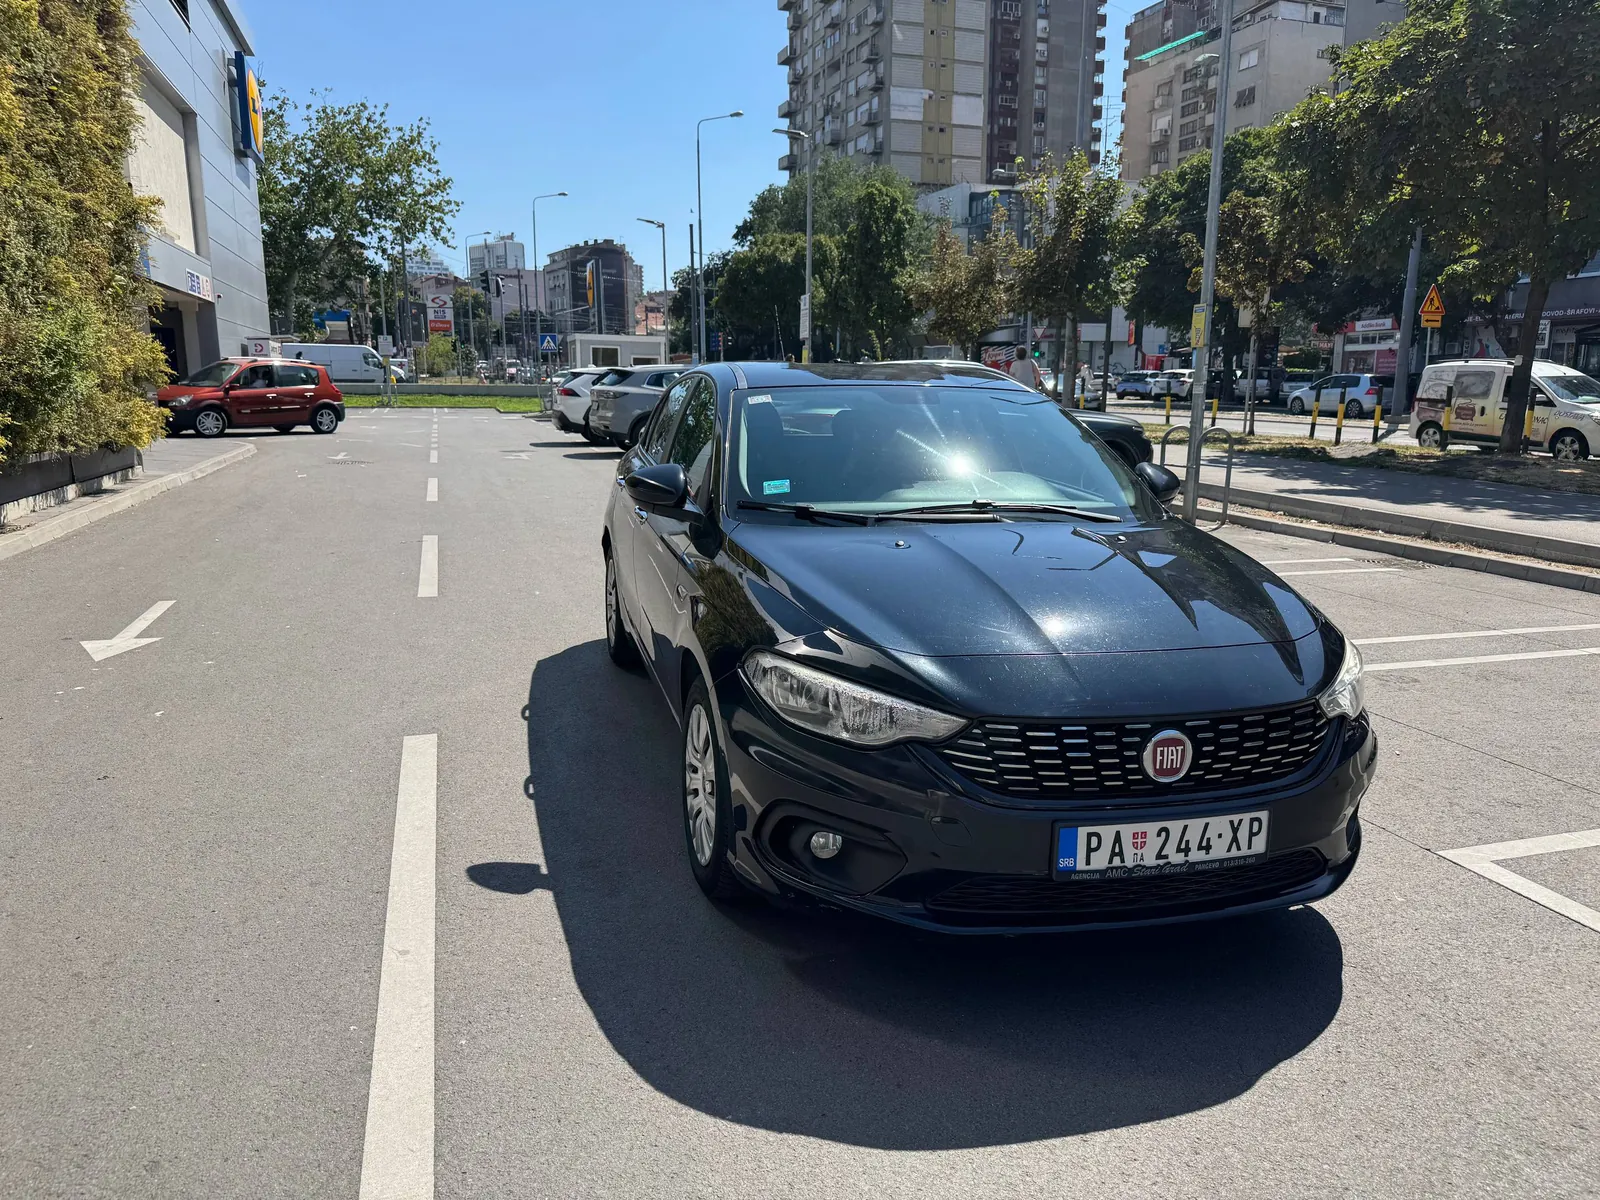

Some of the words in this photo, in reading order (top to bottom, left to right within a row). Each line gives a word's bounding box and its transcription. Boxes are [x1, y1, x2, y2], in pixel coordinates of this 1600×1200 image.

[1156, 746, 1184, 769] FIAT
[1085, 830, 1126, 866] PA
[1058, 858, 1075, 868] SRB
[1070, 872, 1100, 880] AGENCIJA
[1105, 867, 1129, 878] AMC
[1131, 865, 1161, 877] Stari
[1161, 862, 1189, 873] Grad
